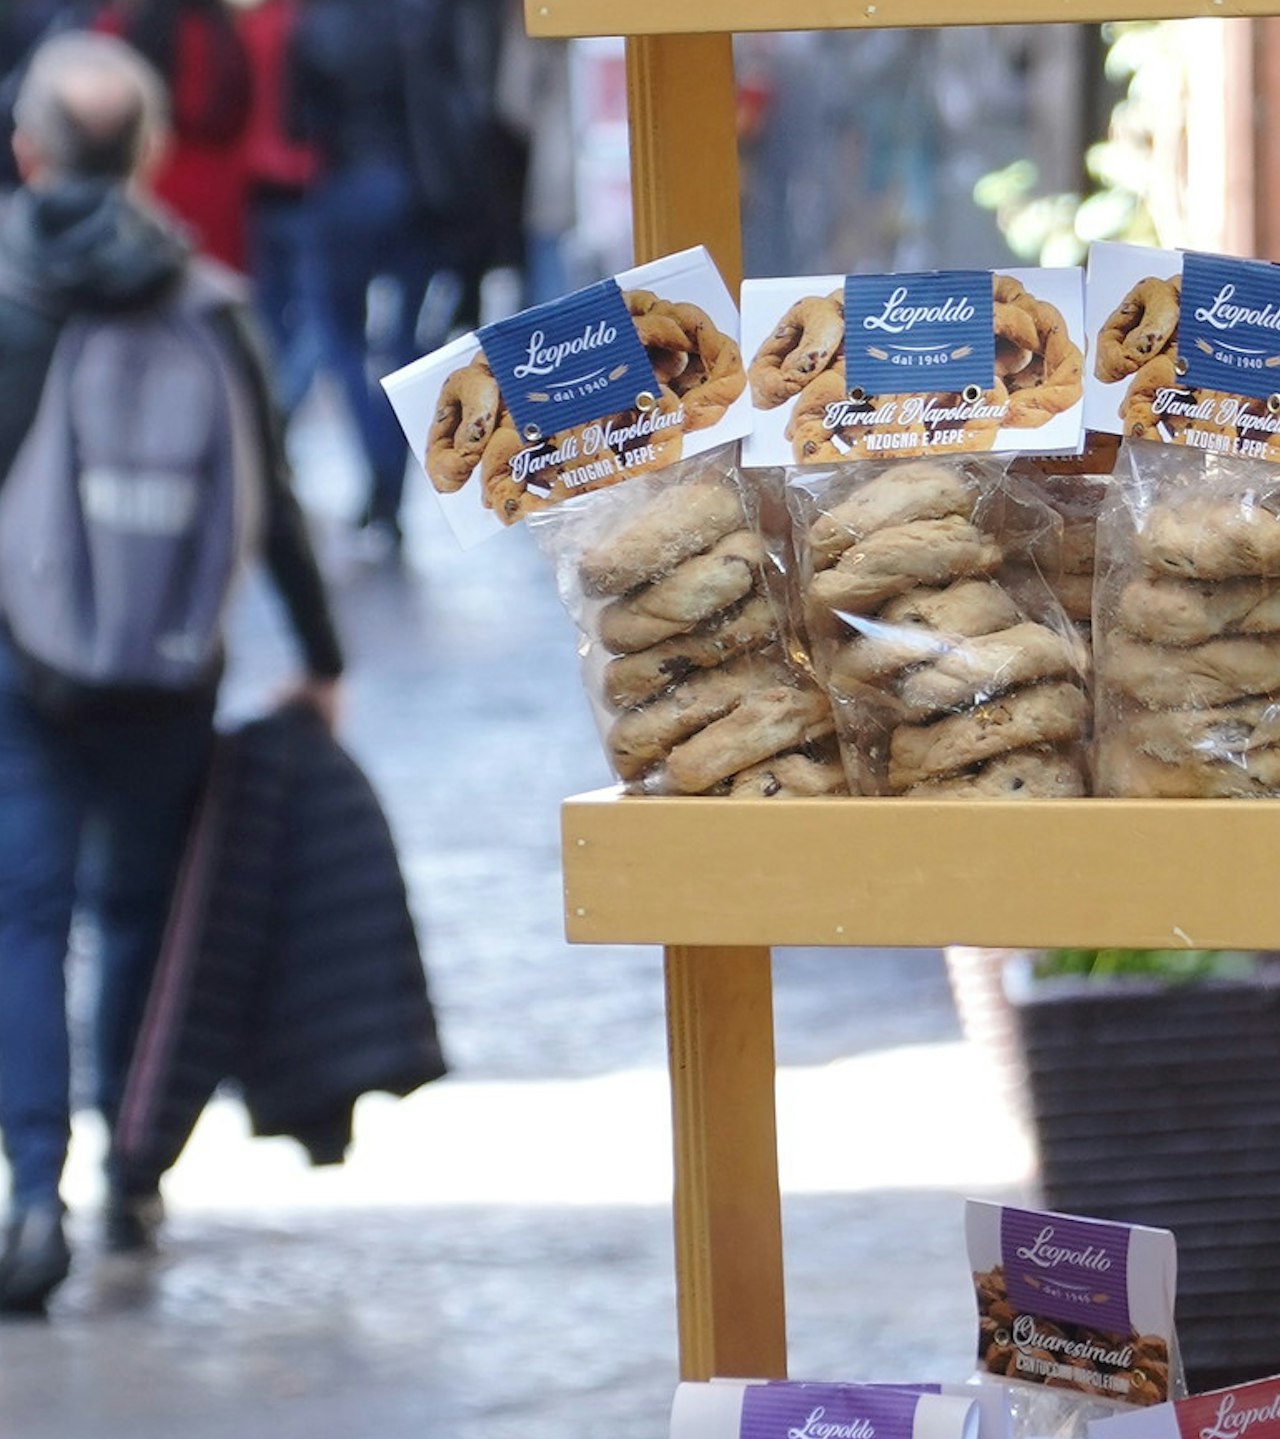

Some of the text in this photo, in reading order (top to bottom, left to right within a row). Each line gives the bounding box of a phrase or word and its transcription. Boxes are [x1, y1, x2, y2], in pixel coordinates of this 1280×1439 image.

[863, 287, 974, 334] Leopoldo
[514, 321, 618, 379] Leopoldo
[891, 351, 948, 365] dal 1940
[1213, 351, 1262, 369] dal 1940
[553, 379, 608, 403] dal 1940
[1150, 386, 1214, 420] Taralli
[822, 396, 1010, 431] Taralli Napoletani
[508, 402, 686, 483] Taralli Napoletani
[921, 432, 930, 448] E
[930, 429, 964, 447] PEPE
[1230, 437, 1237, 452] E
[1237, 438, 1267, 458] PEPE
[616, 452, 626, 472] E
[624, 445, 657, 471] PEPE
[1017, 1226, 1112, 1272] Leopoldo
[1013, 1315, 1133, 1368] Quaresimali
